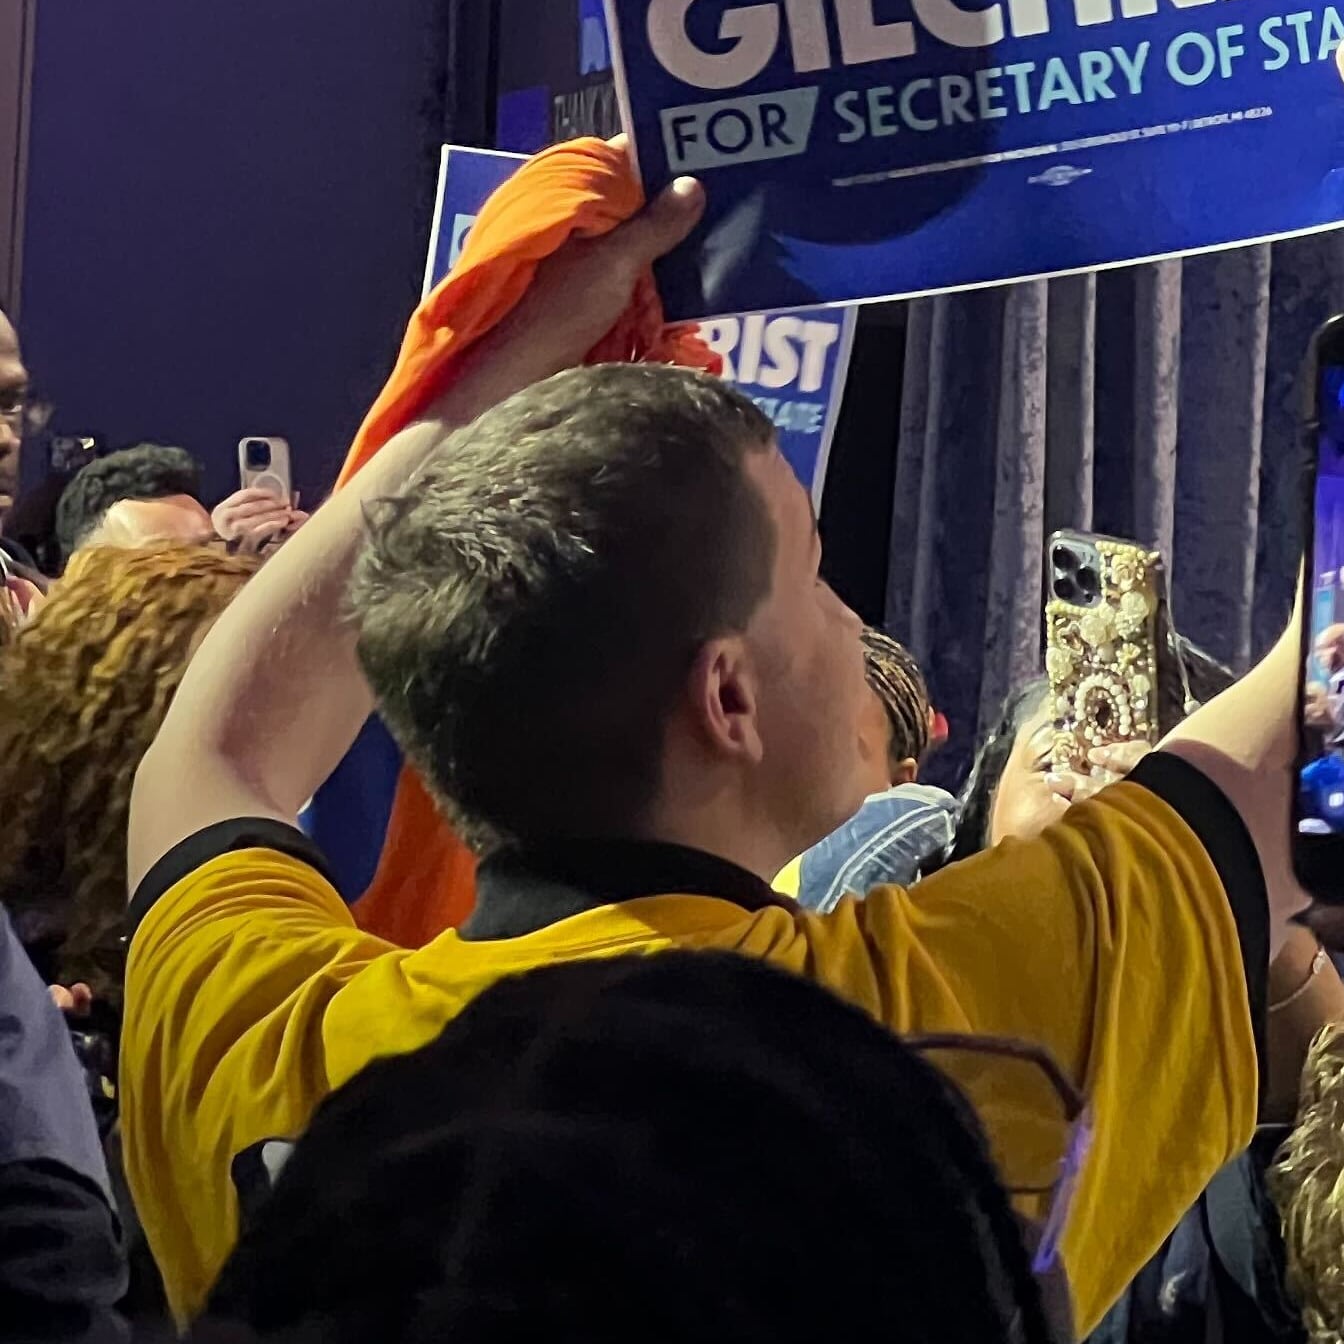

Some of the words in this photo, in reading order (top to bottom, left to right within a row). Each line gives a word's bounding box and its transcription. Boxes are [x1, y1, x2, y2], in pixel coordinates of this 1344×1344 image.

[671, 101, 794, 162] FOR
[833, 38, 1153, 144] SECRETARY
[1165, 22, 1245, 86] OF
